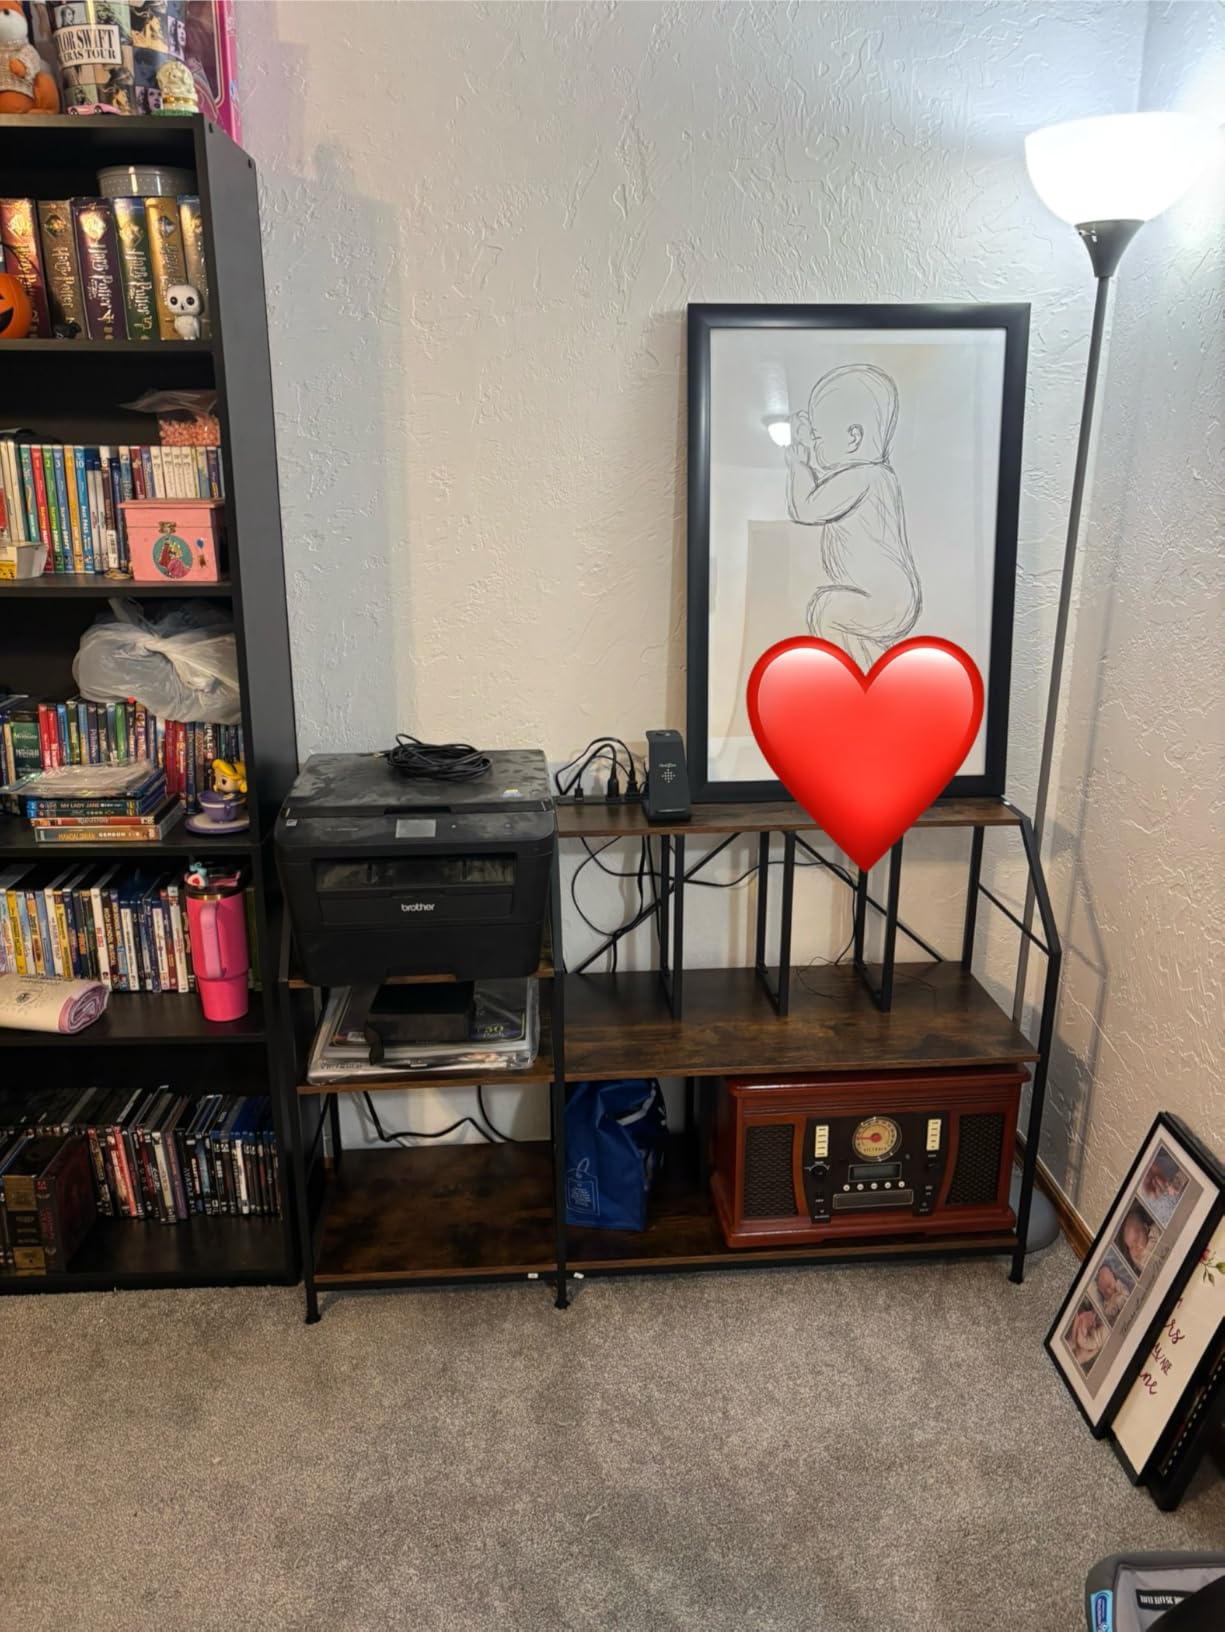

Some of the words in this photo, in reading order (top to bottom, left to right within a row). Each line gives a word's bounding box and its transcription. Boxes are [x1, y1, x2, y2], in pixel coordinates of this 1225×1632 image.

[77, 29, 114, 49] SWIFT
[85, 48, 116, 60] TOUR
[52, 247, 71, 275] Harry
[88, 244, 109, 272] Harry
[125, 248, 149, 281] Harry
[54, 276, 75, 308] Potter
[88, 275, 113, 309] Potter
[128, 281, 152, 315] Potter
[97, 309, 115, 324] 4
[75, 460, 85, 469] 10
[401, 902, 436, 912] brother
